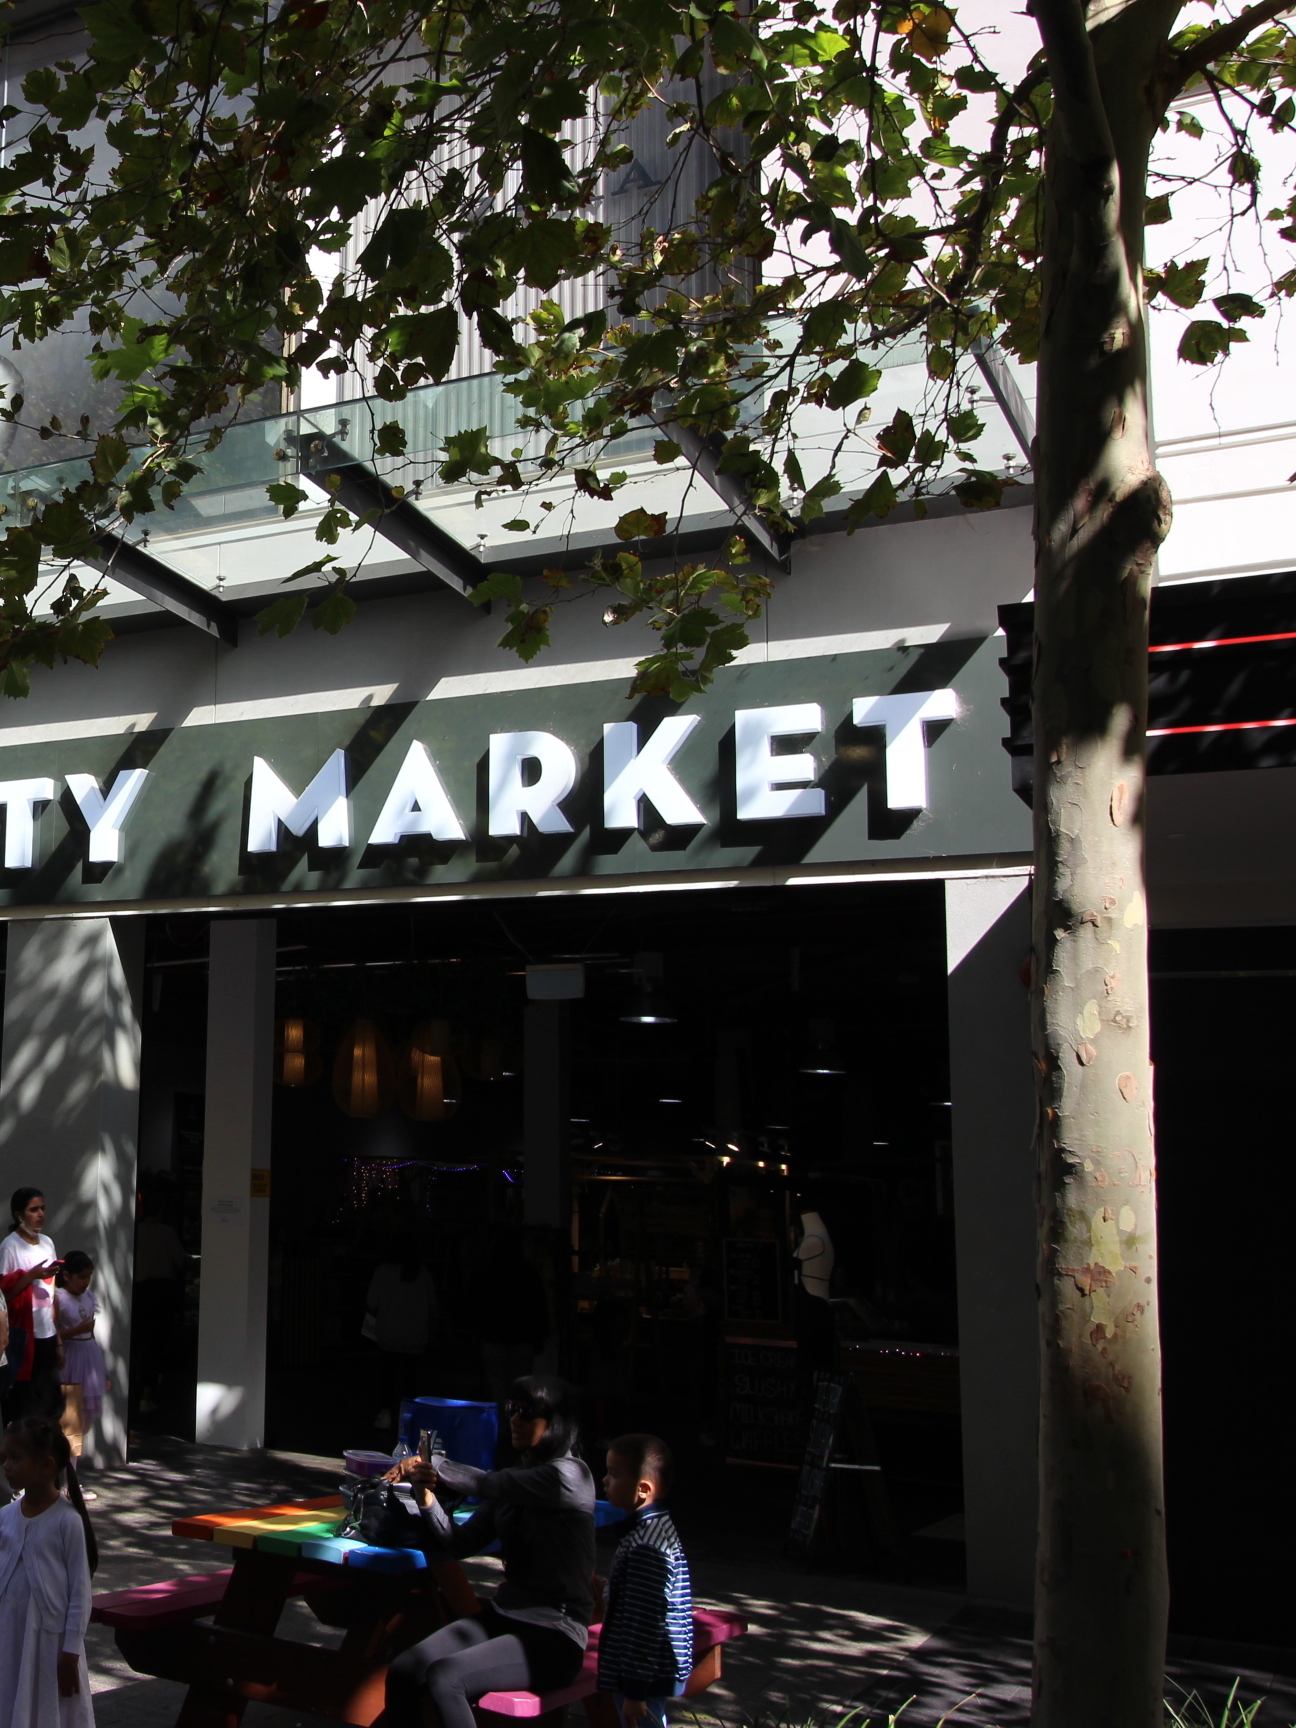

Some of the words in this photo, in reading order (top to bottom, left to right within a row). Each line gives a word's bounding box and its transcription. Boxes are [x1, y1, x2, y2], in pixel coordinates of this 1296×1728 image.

[246, 687, 960, 854] MARKET
[730, 1349, 758, 1366] ICE
[734, 1373, 797, 1399] SLUSHY
[730, 1429, 804, 1453] WAFFLES
